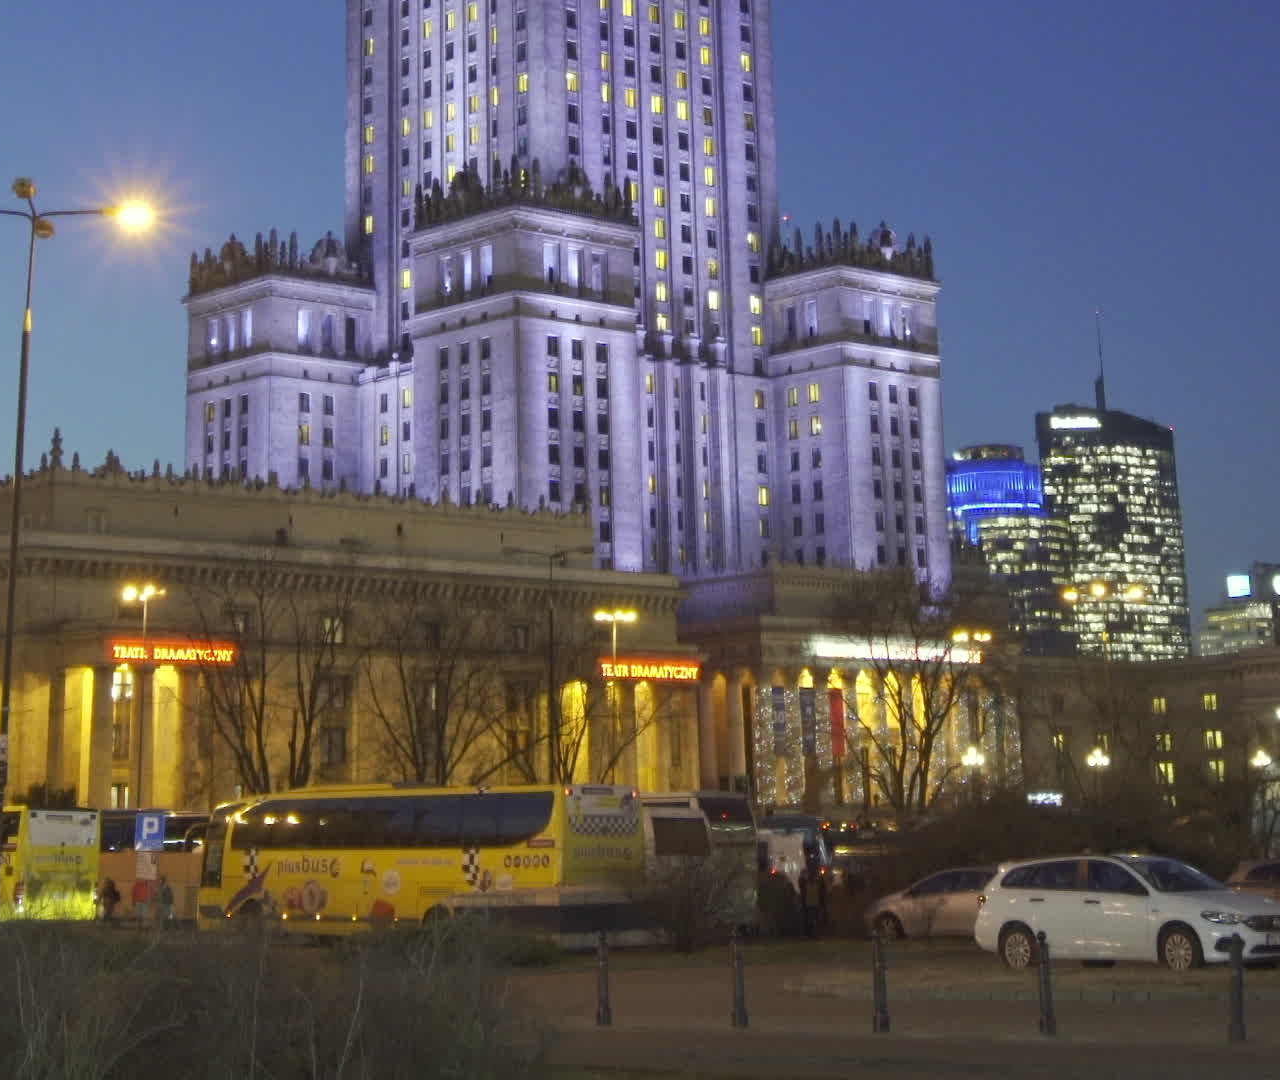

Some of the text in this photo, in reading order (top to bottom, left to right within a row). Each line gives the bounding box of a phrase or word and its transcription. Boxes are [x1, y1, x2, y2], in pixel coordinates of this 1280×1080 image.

[601, 663, 698, 680] TEATR DRAMATYCZNY
[143, 816, 160, 840] P
